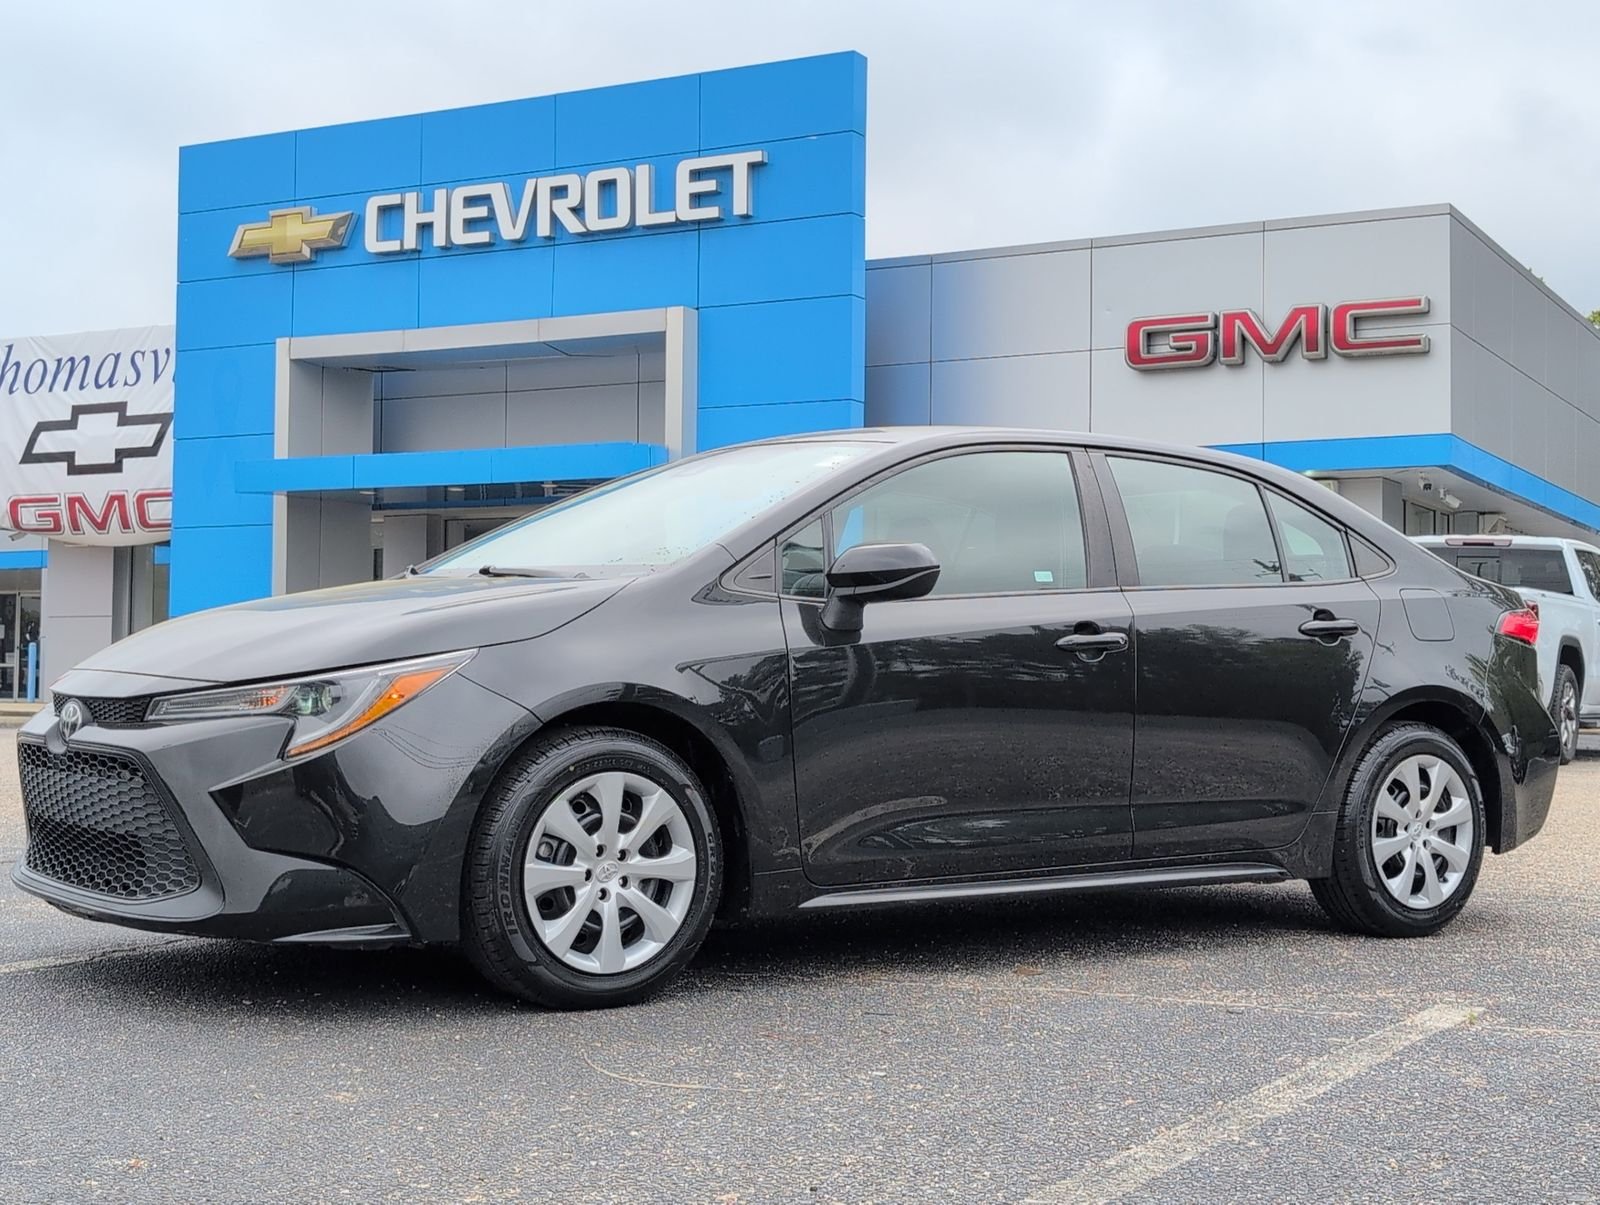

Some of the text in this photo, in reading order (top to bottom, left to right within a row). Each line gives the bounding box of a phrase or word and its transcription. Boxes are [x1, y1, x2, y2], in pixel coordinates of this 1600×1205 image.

[365, 150, 767, 254] CHEVROLET
[1125, 295, 1430, 371] GMC
[0, 343, 175, 395] homasv
[7, 489, 172, 537] GMC
